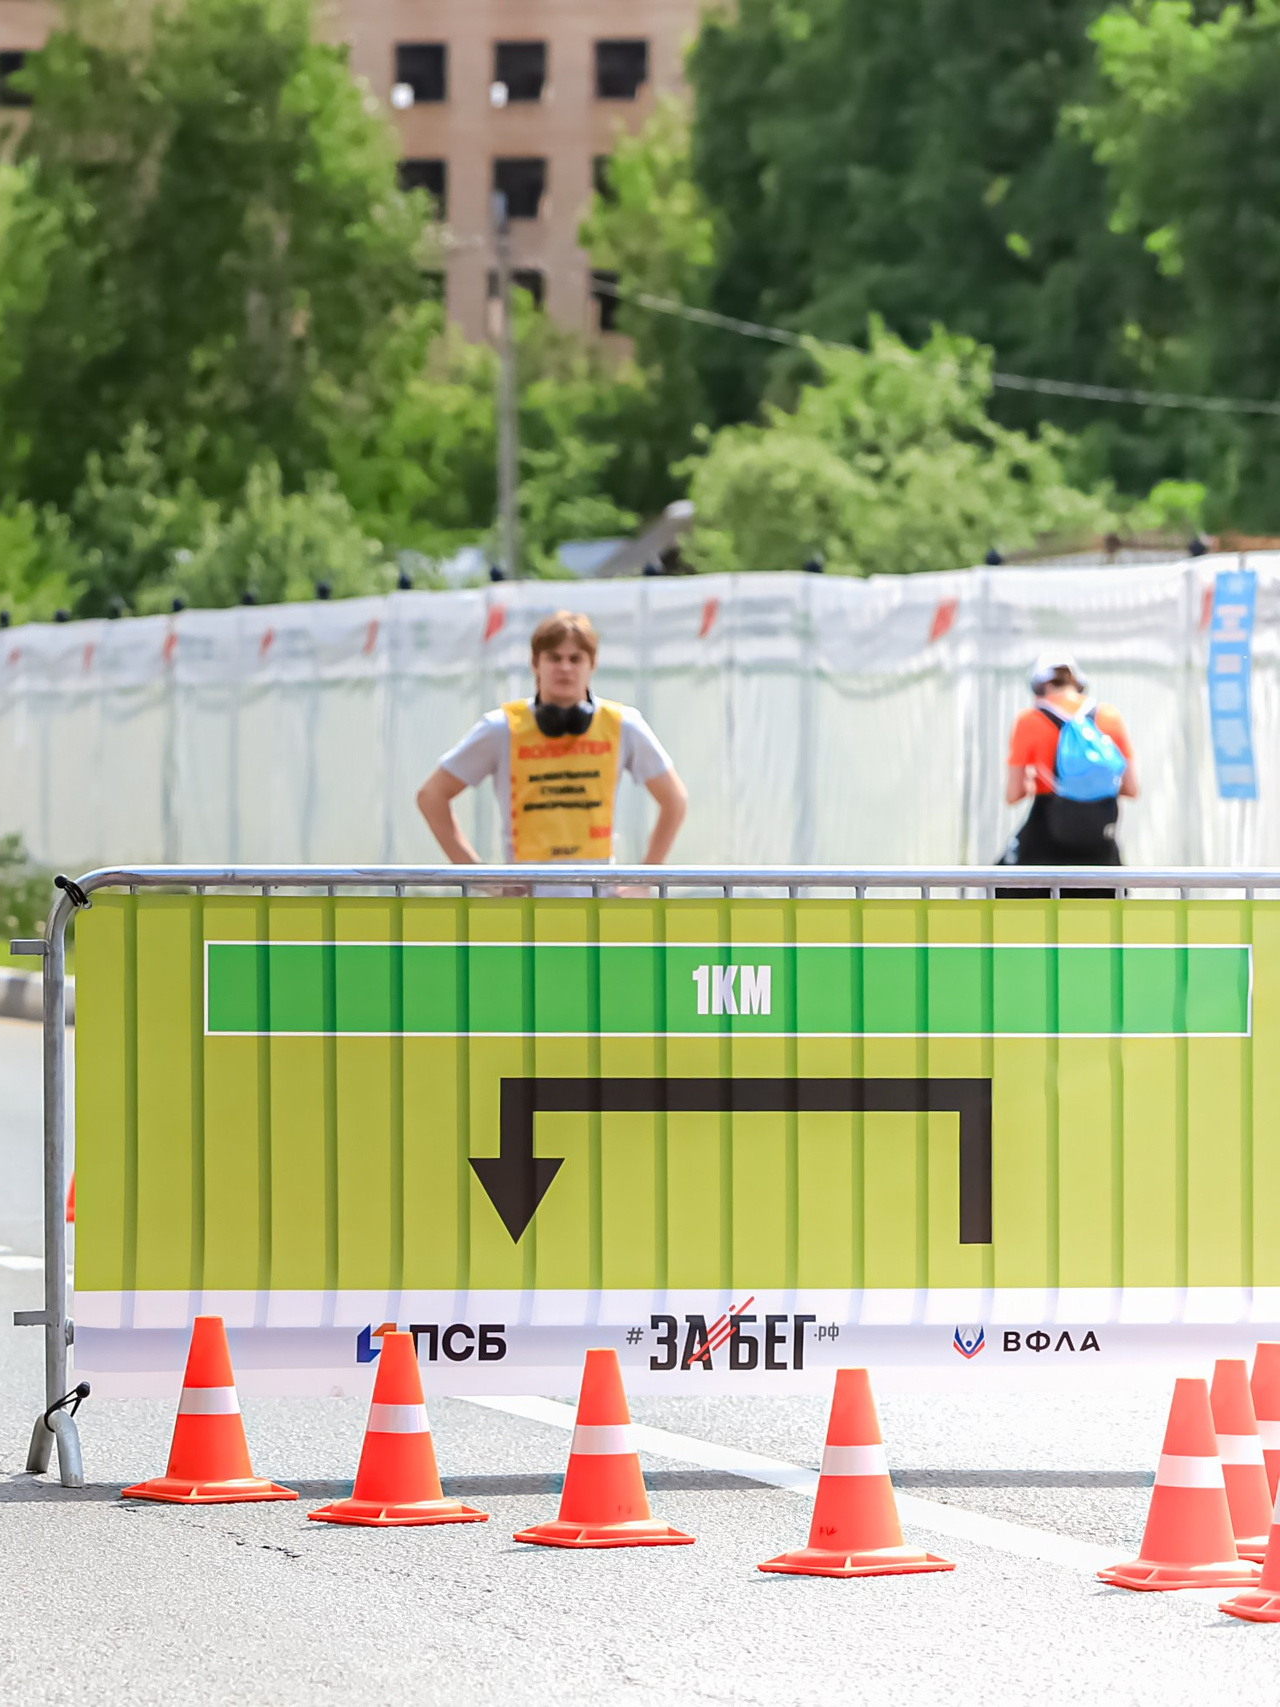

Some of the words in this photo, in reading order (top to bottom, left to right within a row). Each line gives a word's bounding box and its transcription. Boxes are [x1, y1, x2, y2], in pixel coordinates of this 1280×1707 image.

[692, 965, 771, 1015] 1KM
[409, 1323, 507, 1362] ПСБ
[1003, 1330, 1101, 1353] ВФЛА
